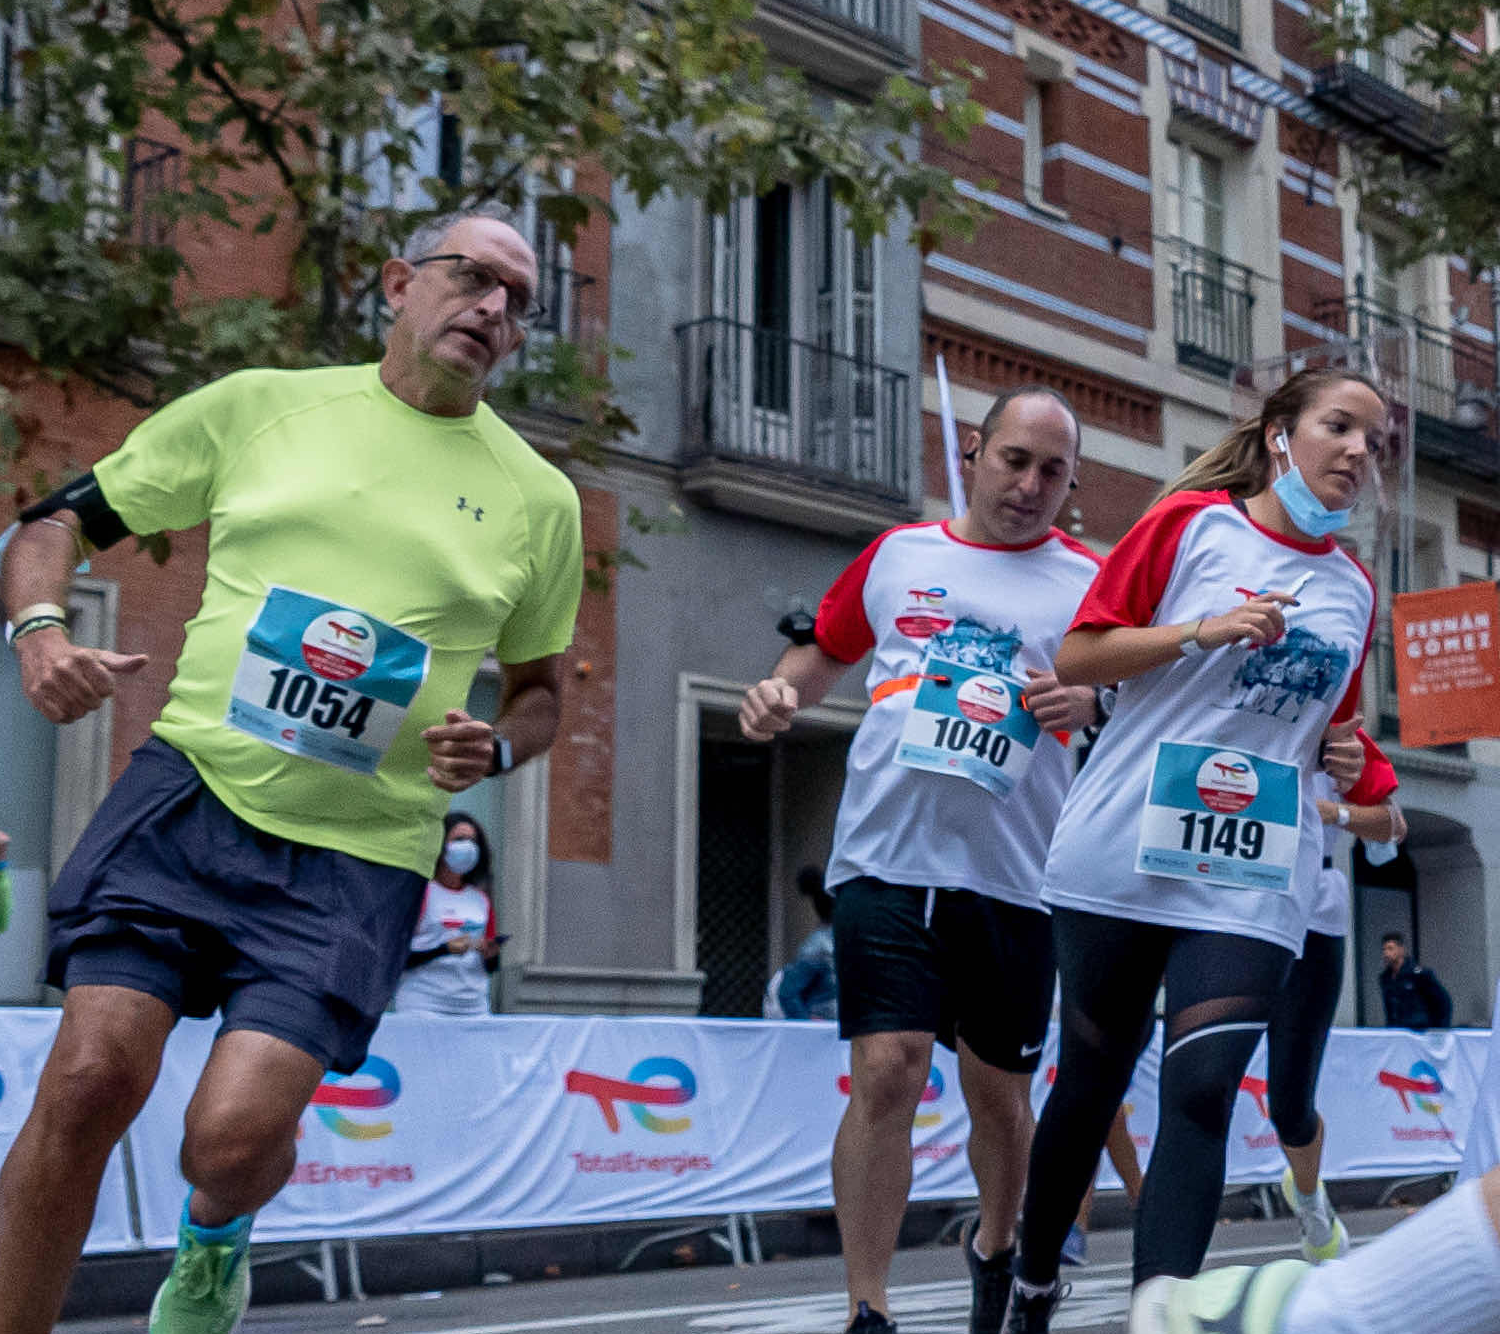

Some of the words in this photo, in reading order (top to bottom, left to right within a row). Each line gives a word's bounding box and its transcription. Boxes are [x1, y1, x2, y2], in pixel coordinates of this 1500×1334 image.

[266, 668, 376, 740] 1054
[933, 716, 1011, 768] 1040
[1177, 812, 1265, 860] 1149
